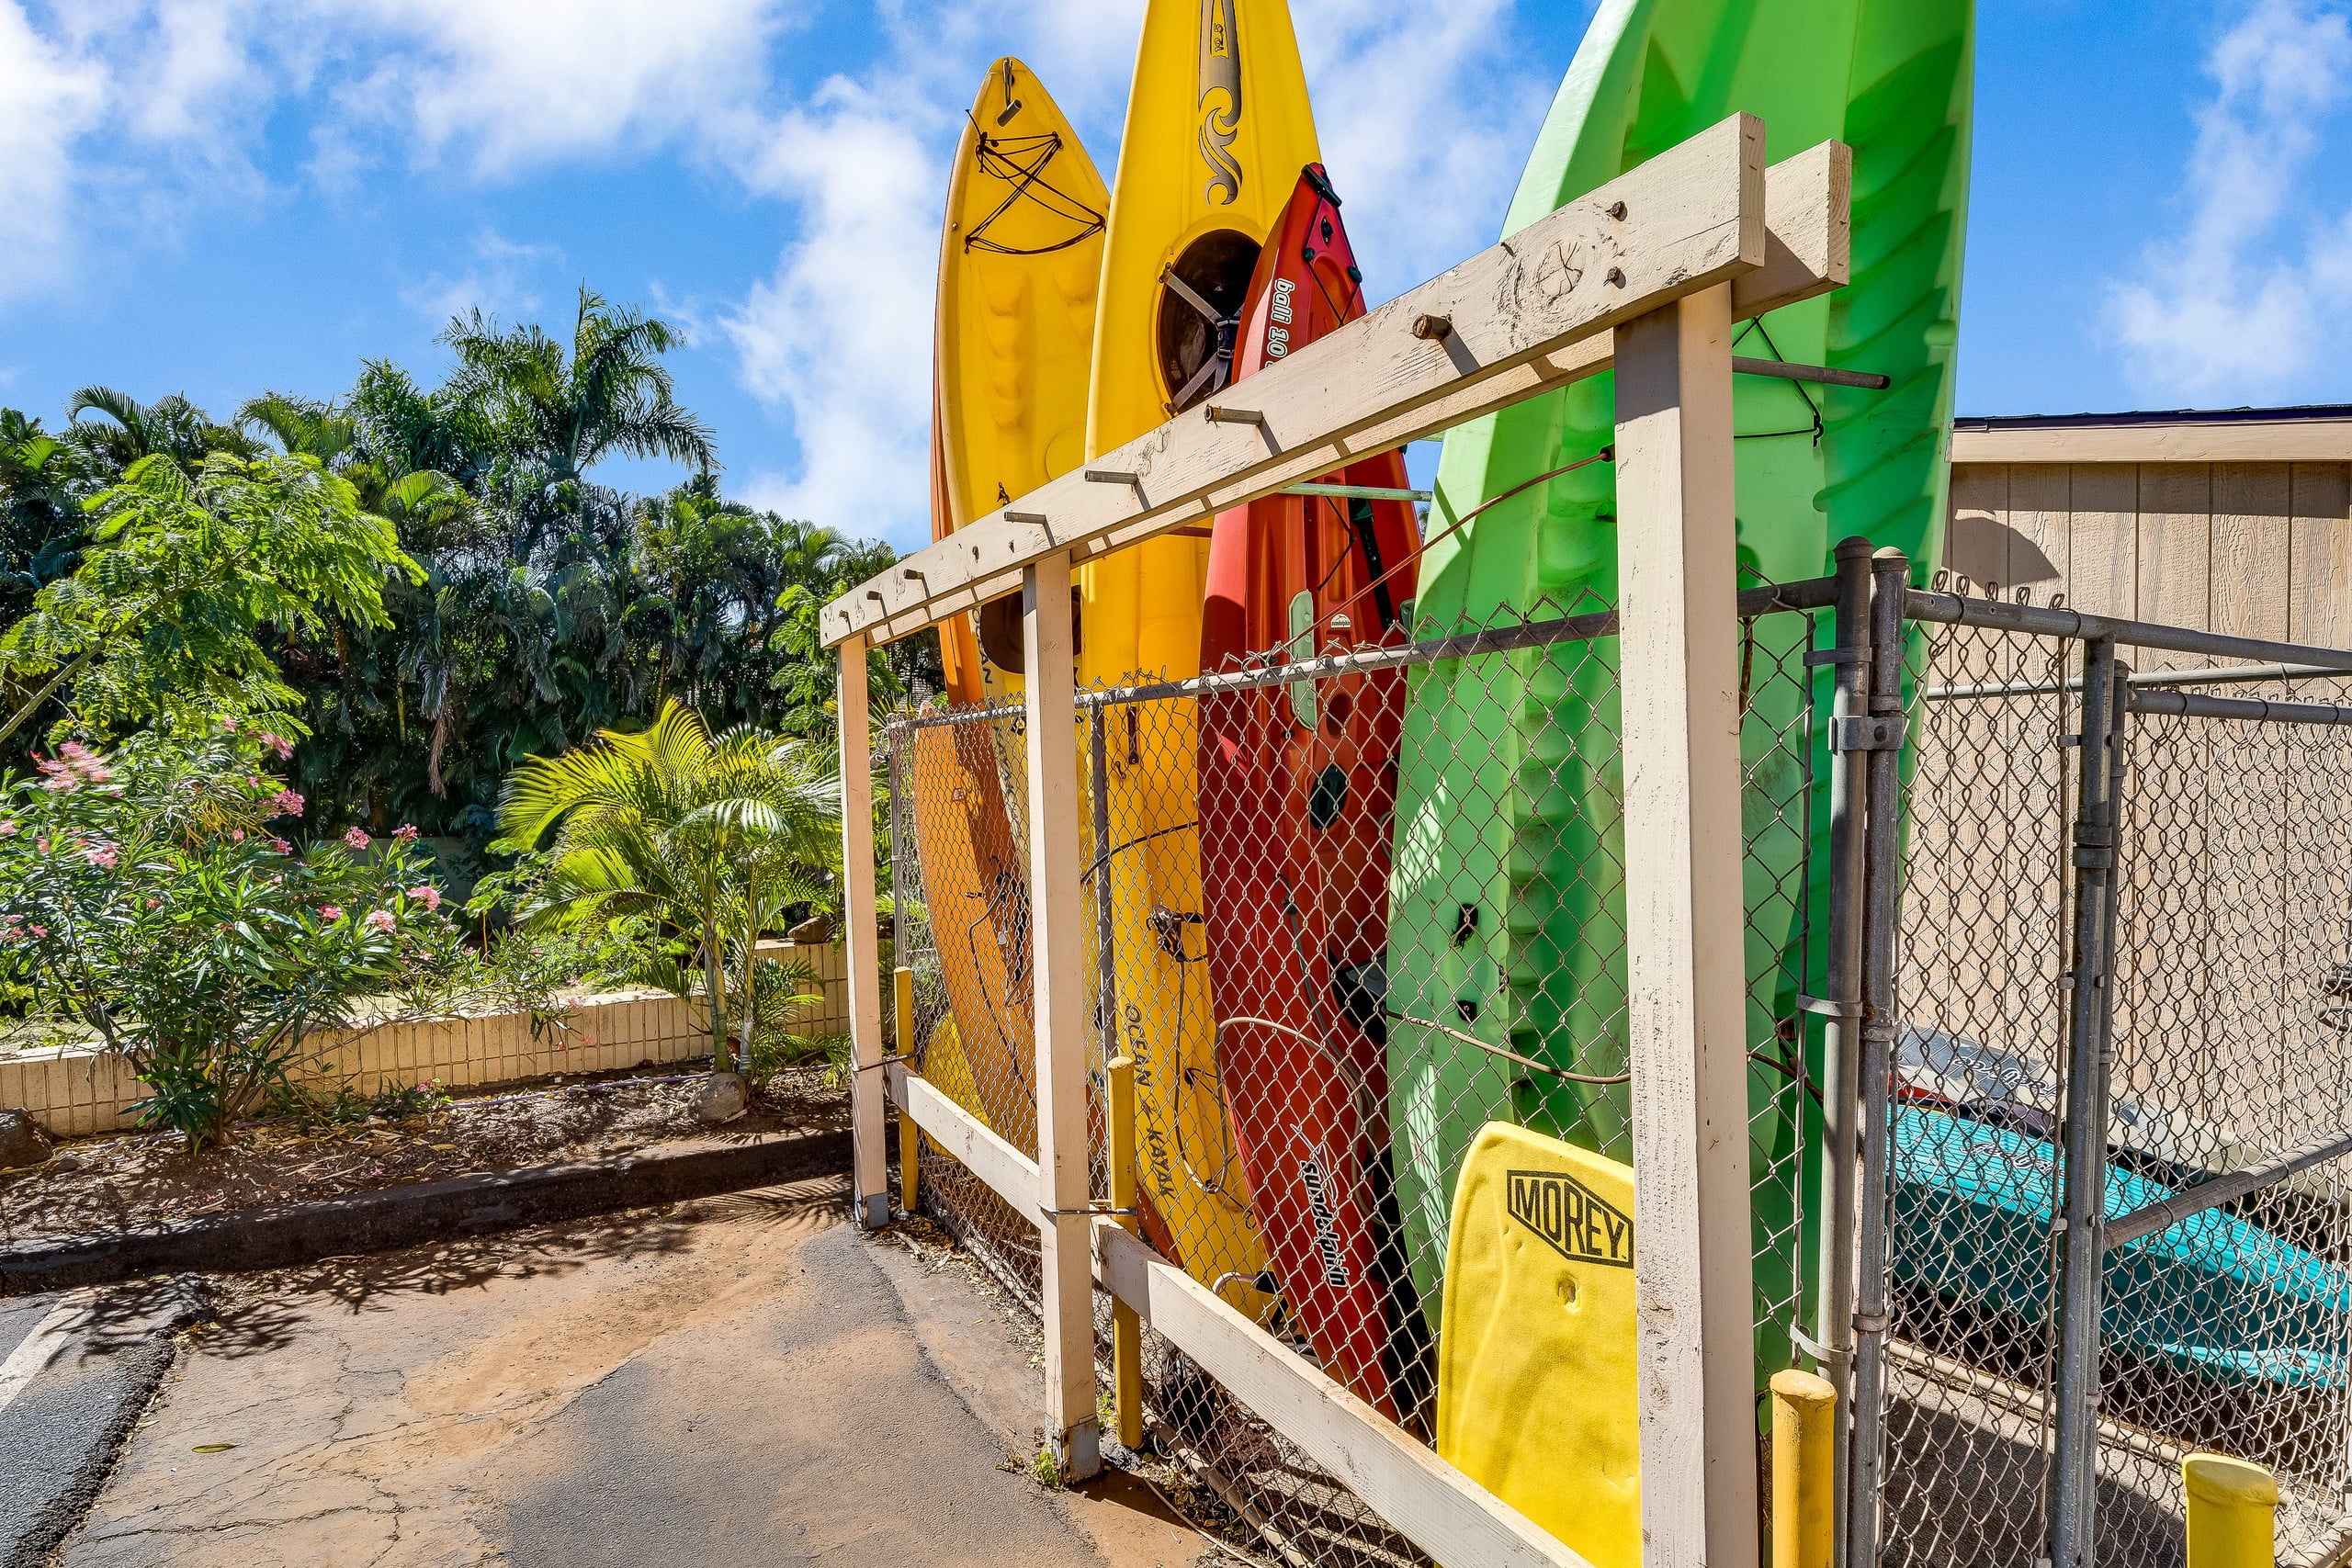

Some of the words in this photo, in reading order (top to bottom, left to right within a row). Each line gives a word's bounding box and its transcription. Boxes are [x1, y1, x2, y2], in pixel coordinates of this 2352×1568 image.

[1272, 277, 1295, 324] bali
[1267, 326, 1290, 358] 10
[1125, 1002, 1153, 1088] OCEAN
[1146, 1127, 1176, 1201] KAYAK
[1299, 1160, 1350, 1288] sundolphin
[1515, 1178, 1625, 1258] MOREY
